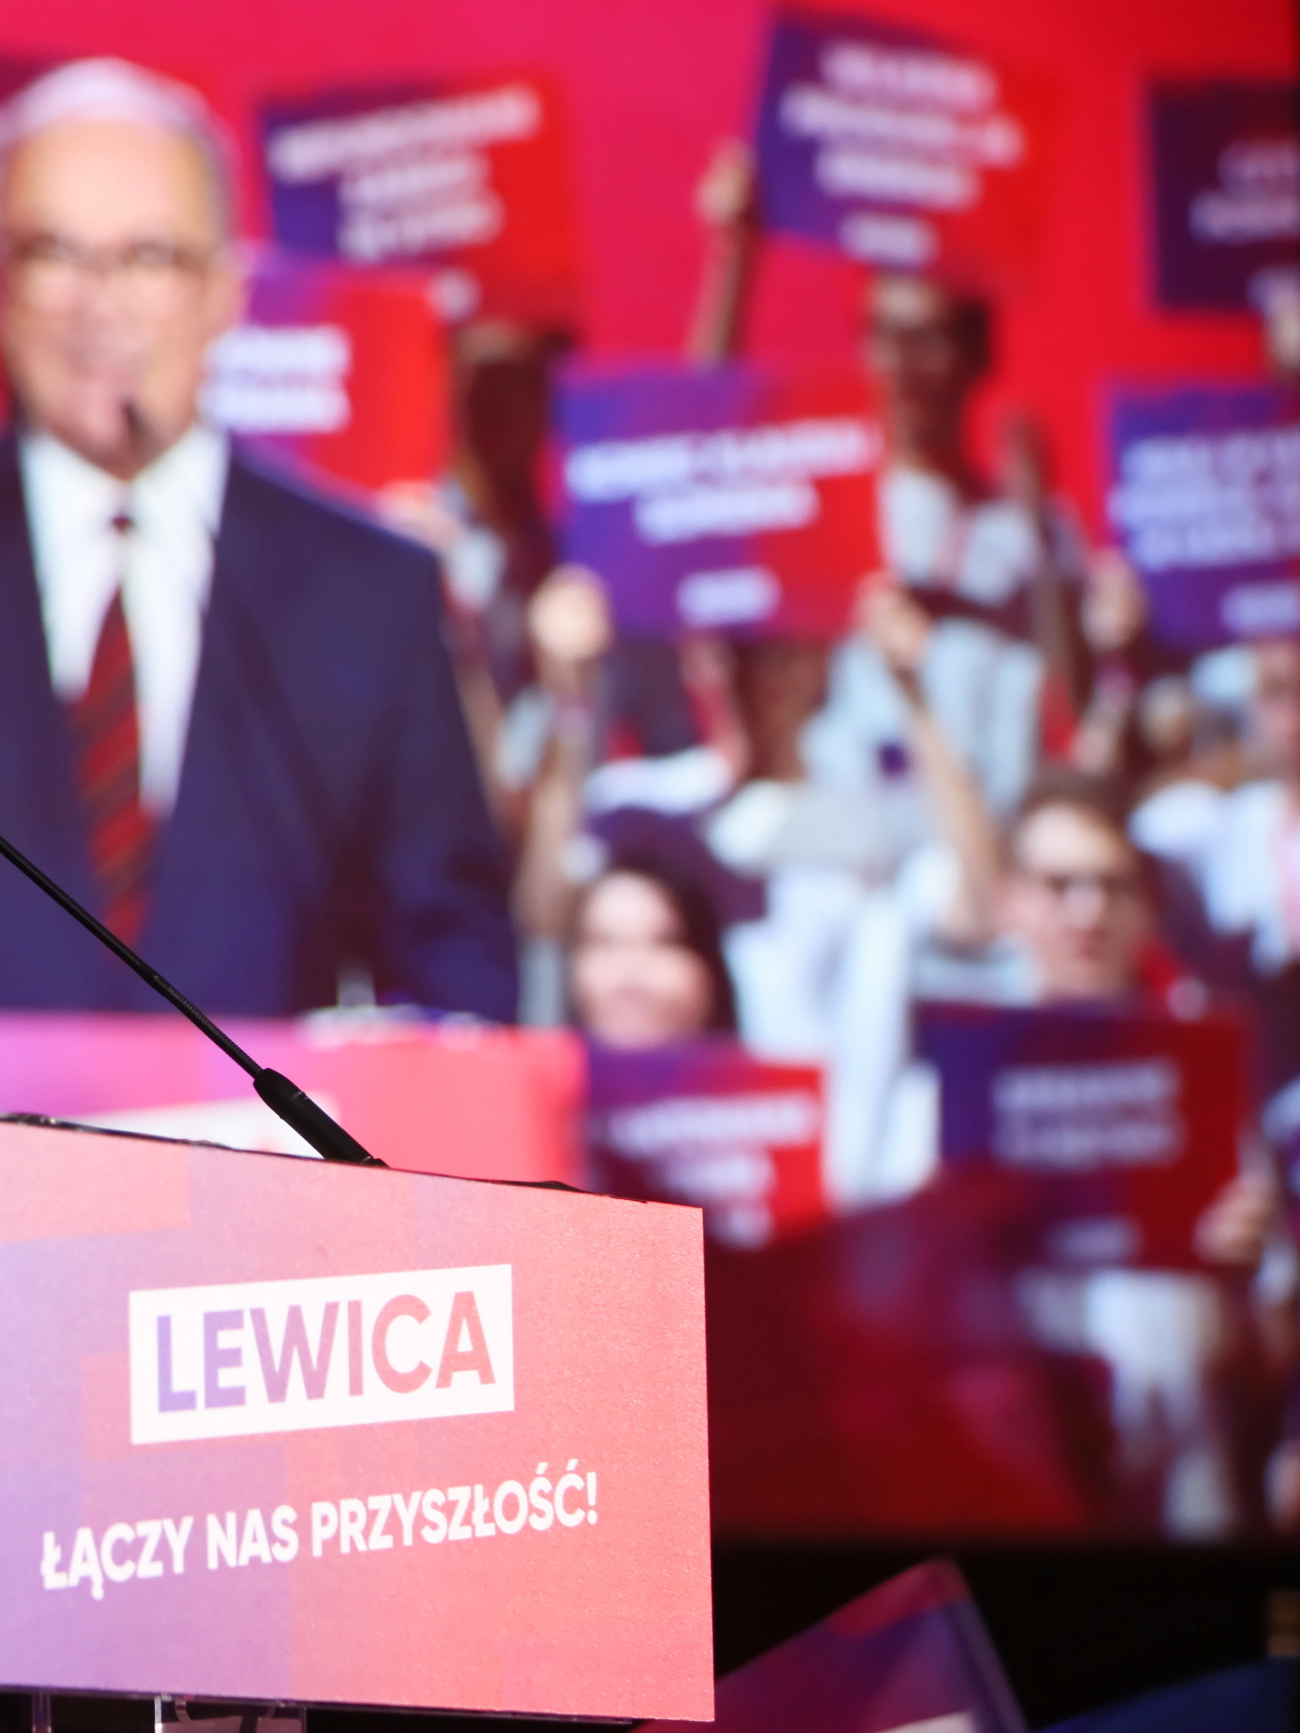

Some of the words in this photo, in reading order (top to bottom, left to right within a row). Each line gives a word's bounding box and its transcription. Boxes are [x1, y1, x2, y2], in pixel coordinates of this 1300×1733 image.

[157, 1291, 496, 1413] LEWICA
[41, 1516, 194, 1600] ŁĄCZY
[206, 1505, 299, 1570] NAS
[312, 1459, 598, 1557] PRZYSZŁOŚĆ!
